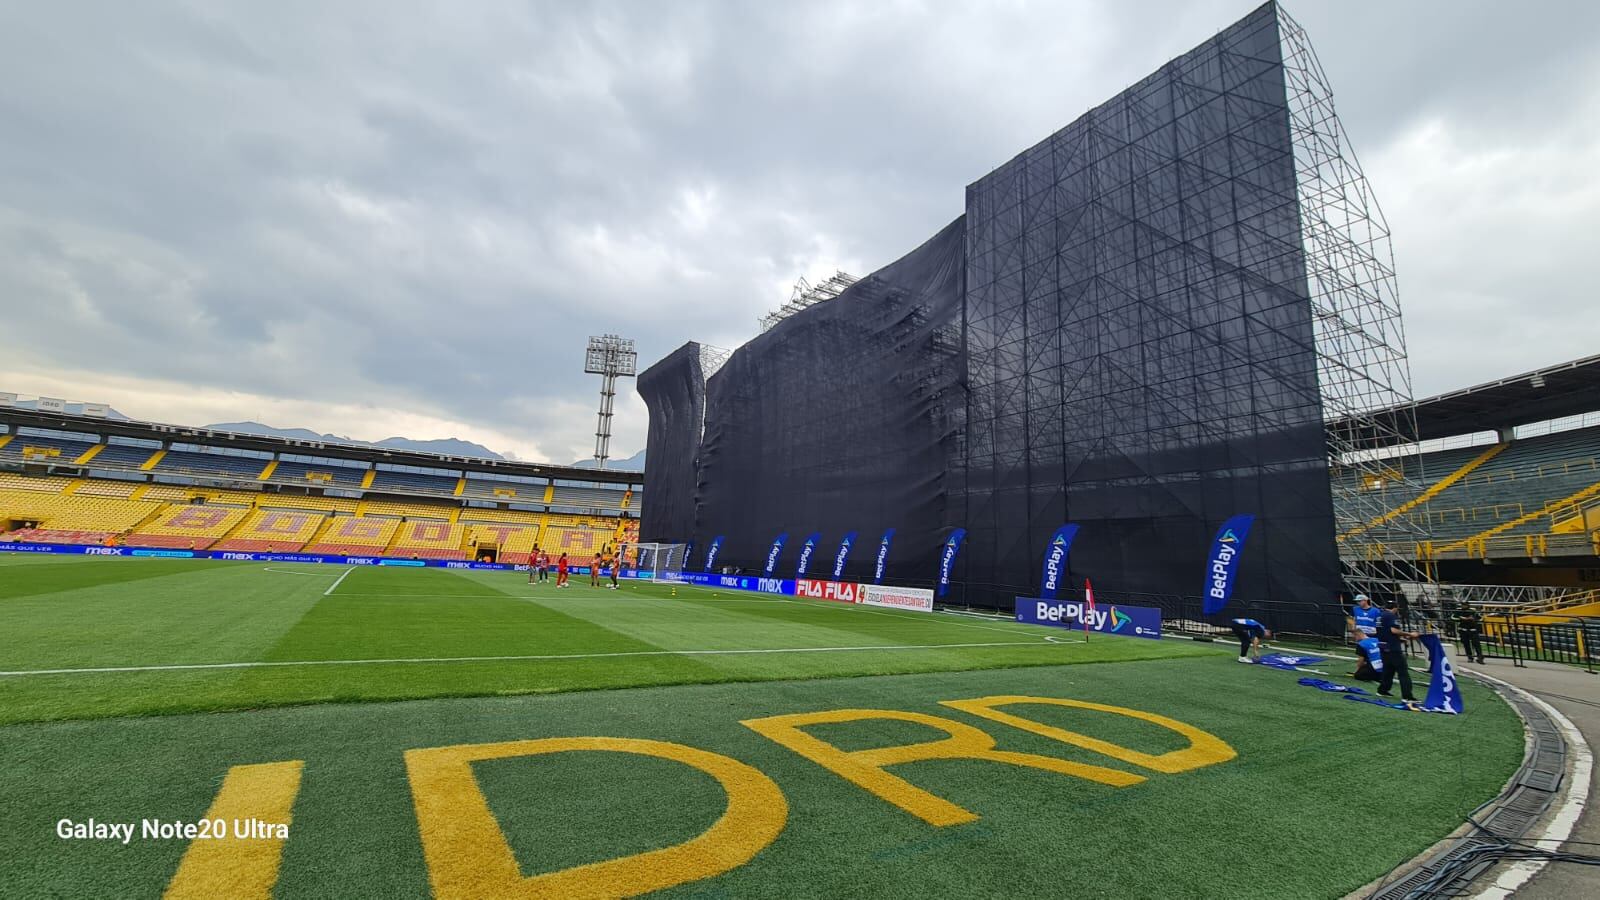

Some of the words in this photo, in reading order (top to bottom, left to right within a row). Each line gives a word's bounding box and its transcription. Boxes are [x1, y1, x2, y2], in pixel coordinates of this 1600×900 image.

[164, 506, 597, 549] BOGOTA
[85, 546, 122, 555] max
[222, 552, 254, 561] max
[346, 557, 374, 565] max
[766, 546, 780, 572] BetPlay
[799, 546, 812, 574] BetPlay
[834, 546, 848, 577] BetPlay
[876, 545, 887, 579] BetPlay
[720, 576, 738, 587] max
[1046, 546, 1064, 590] BetPlay
[1210, 543, 1236, 599] BetPlay
[758, 577, 783, 593] max
[797, 579, 823, 597] FILA
[825, 581, 855, 600] FILA
[1036, 602, 1108, 630] BetPlay
[162, 694, 1238, 900] IDRD
